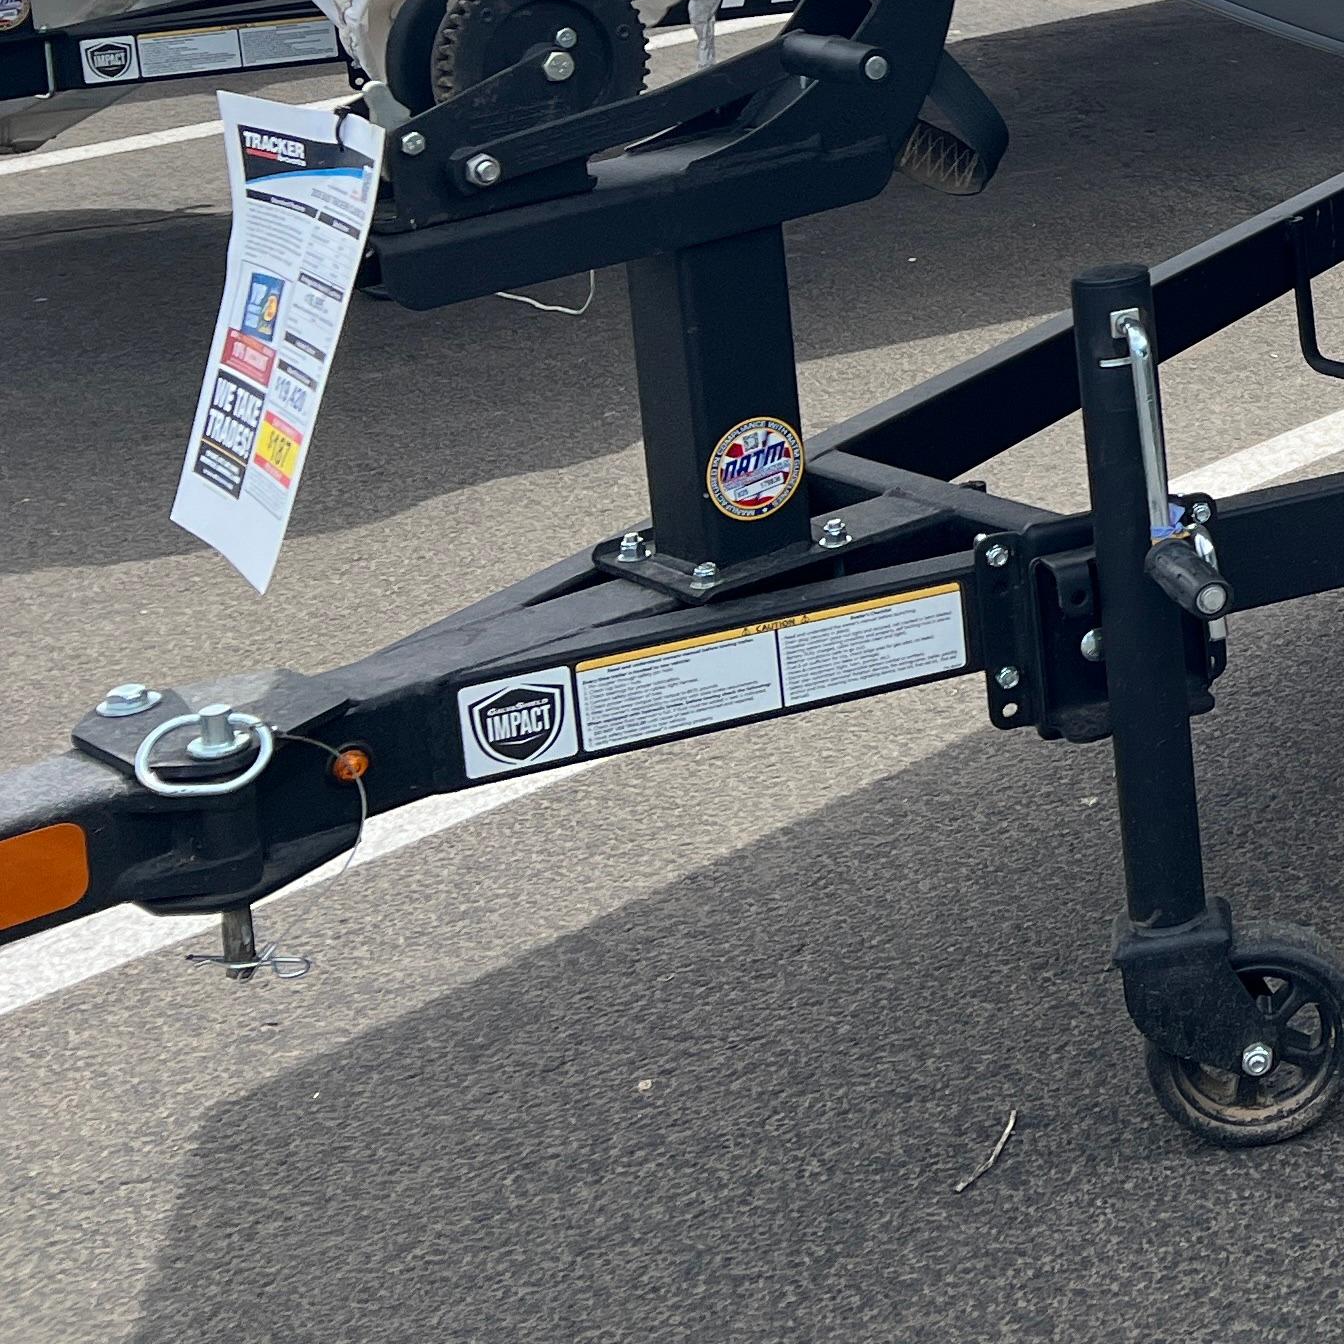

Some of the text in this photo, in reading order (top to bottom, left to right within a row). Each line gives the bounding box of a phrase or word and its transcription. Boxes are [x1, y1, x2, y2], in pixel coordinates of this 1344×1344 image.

[242, 130, 305, 159] TRACKER
[213, 377, 263, 427] WE TAKE
[768, 421, 789, 435] WITH
[722, 440, 786, 485] NATM
[756, 618, 796, 633] CAUTION
[486, 704, 551, 743] IMPACT
